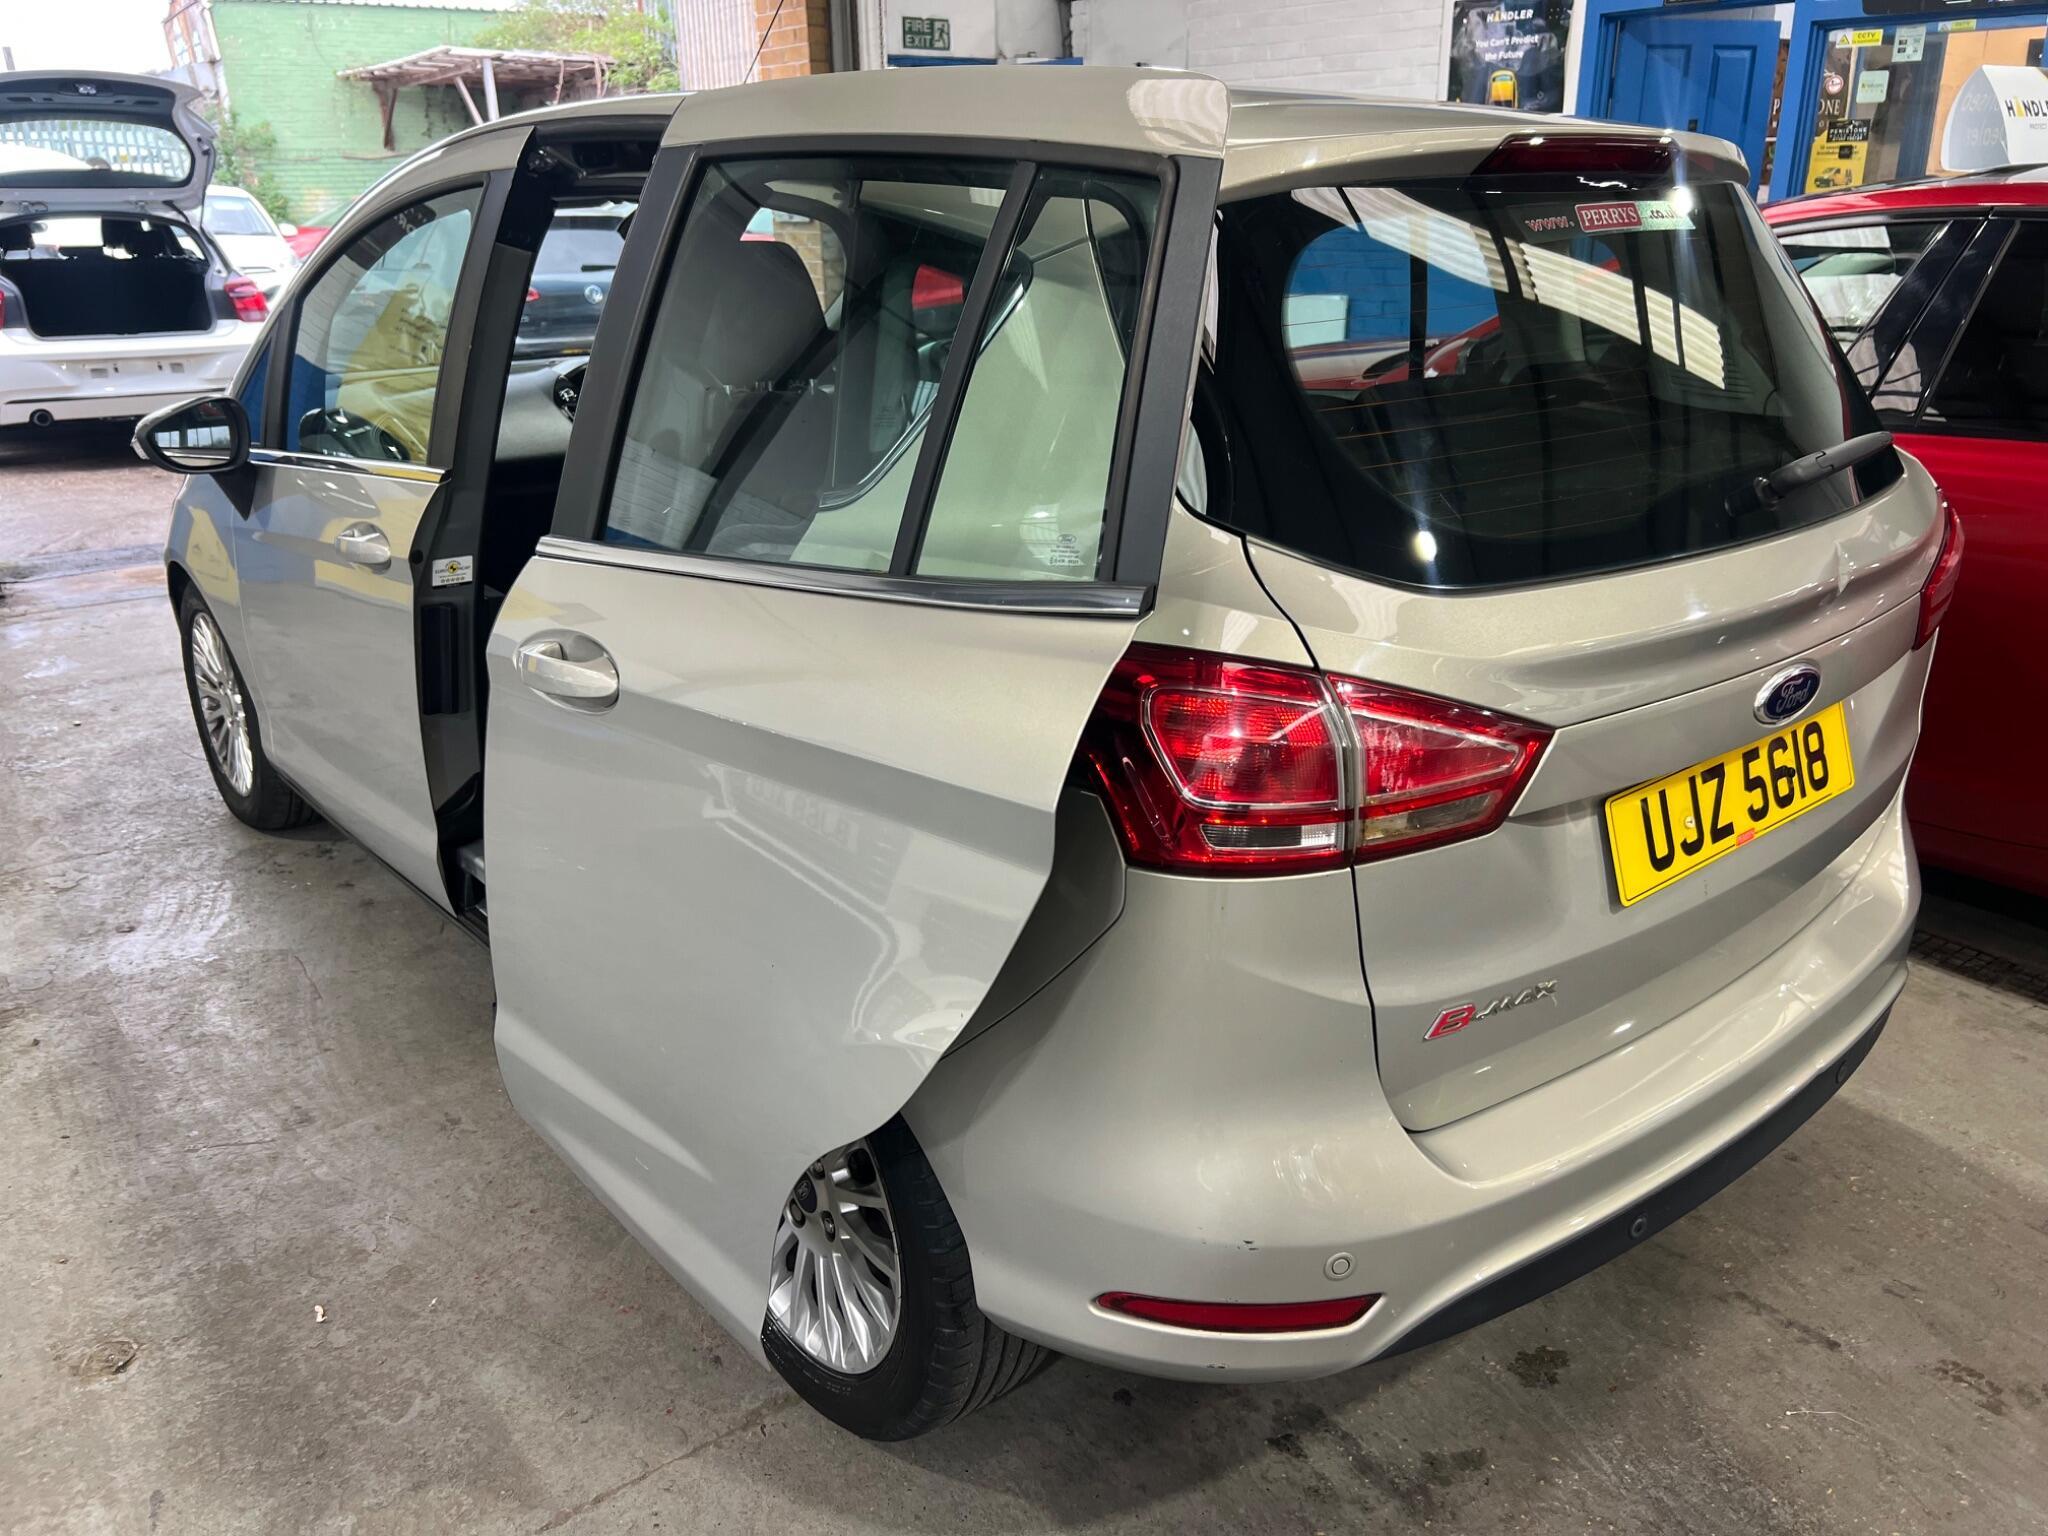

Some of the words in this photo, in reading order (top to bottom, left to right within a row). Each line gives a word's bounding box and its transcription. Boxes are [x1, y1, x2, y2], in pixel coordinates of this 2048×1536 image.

[905, 20, 931, 32] FIRE
[905, 35, 932, 47] EXIT
[1475, 39, 1489, 48] You
[1490, 37, 1510, 47] Can't
[1511, 34, 1540, 46] Predict
[1485, 51, 1498, 61] the
[1499, 50, 1525, 60] Future
[1580, 207, 1639, 226] PERRYS
[1649, 205, 1685, 221] .co.u
[1775, 677, 1812, 714] Ford
[1639, 761, 1735, 873] UJZ
[1741, 720, 1829, 823] 5618
